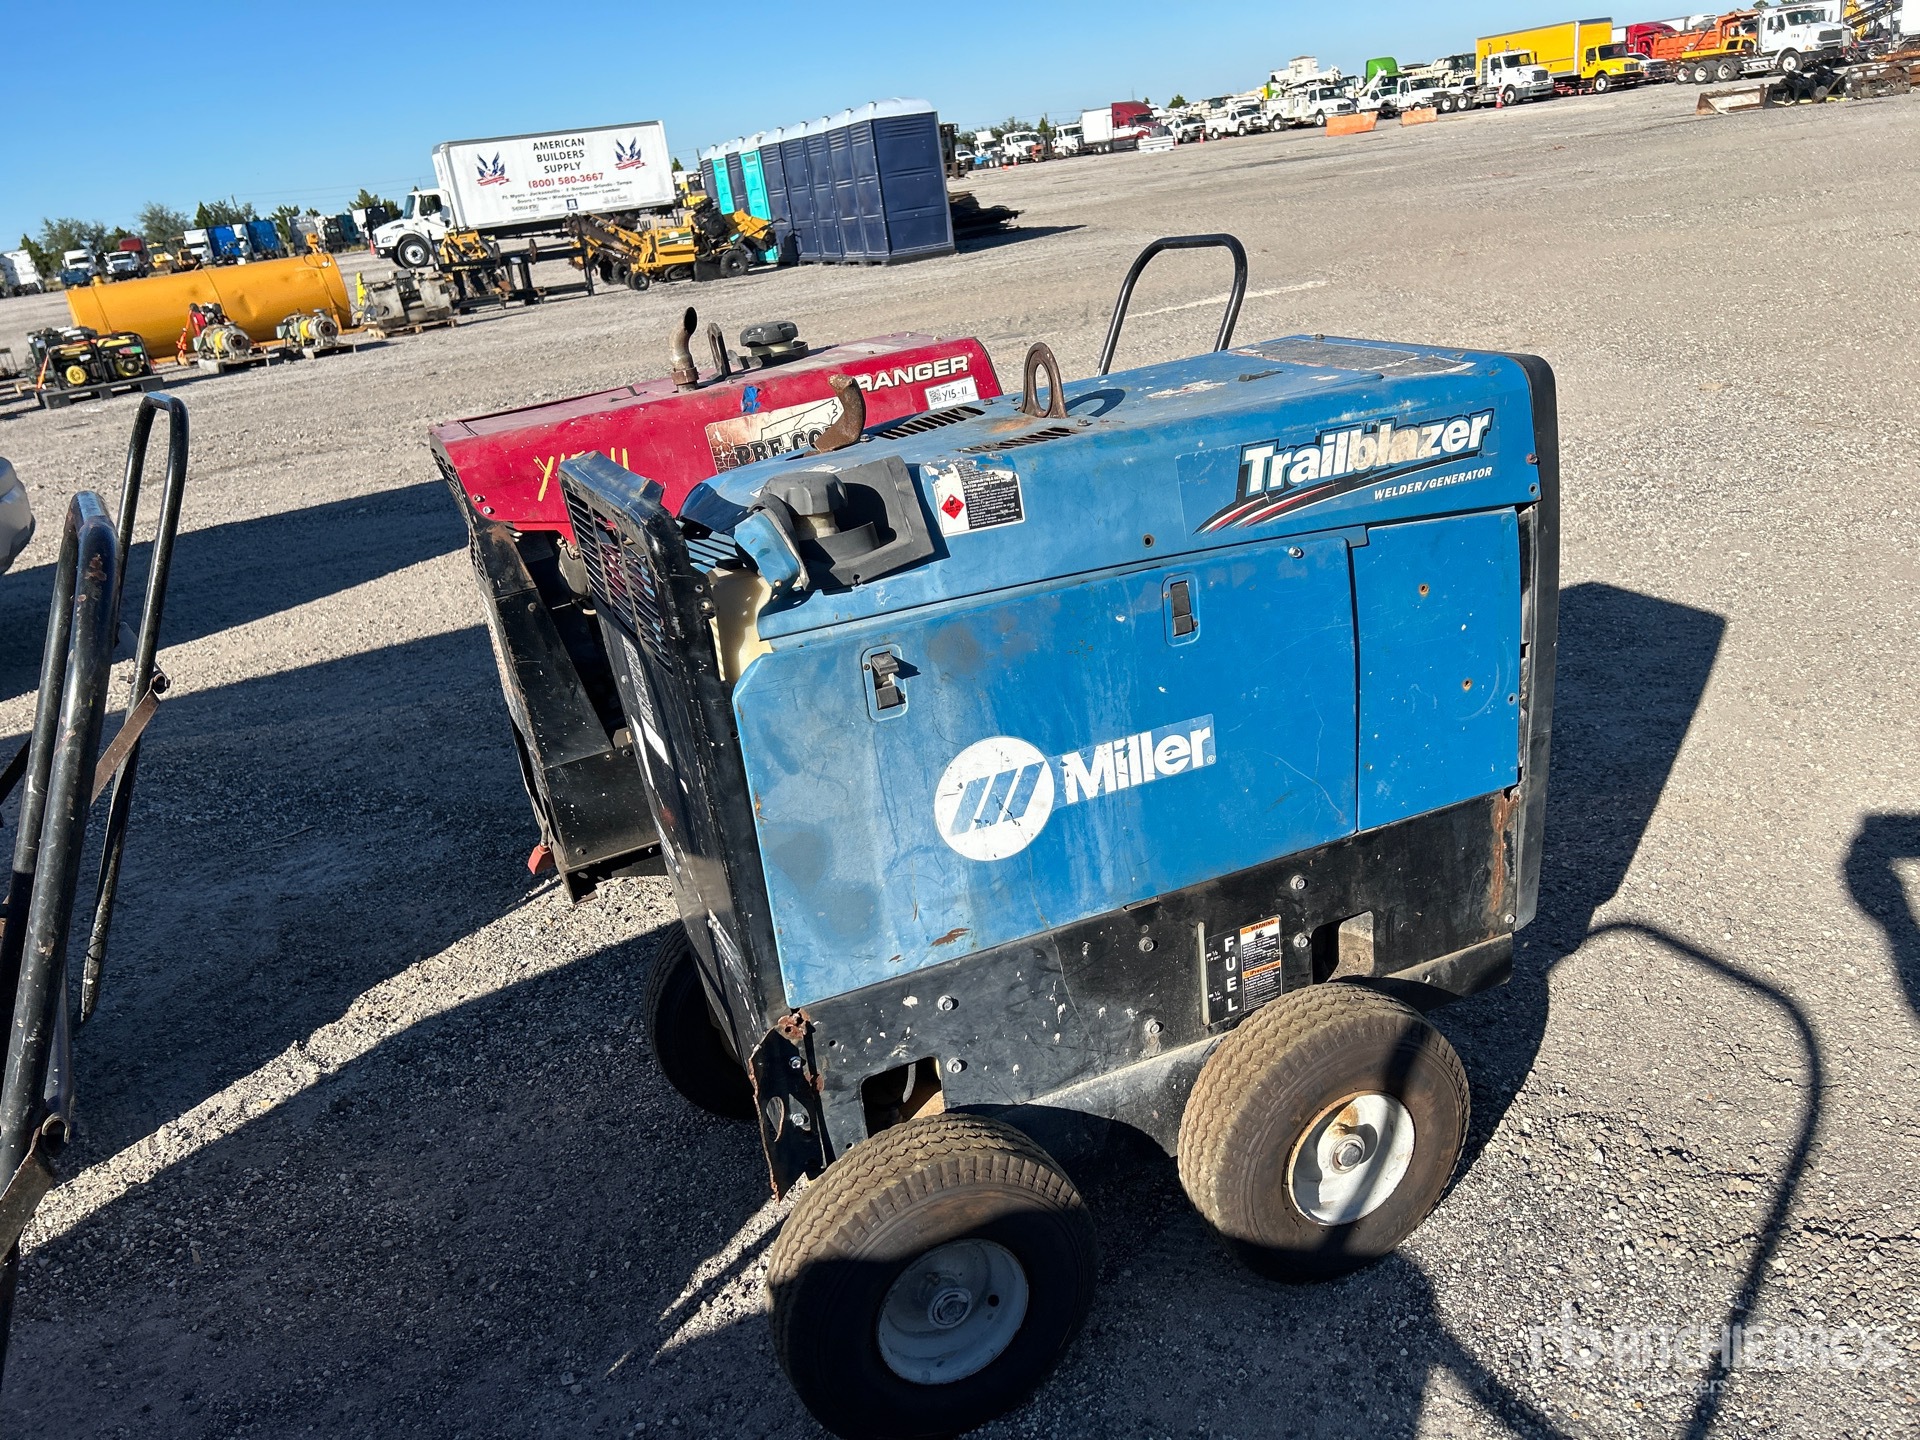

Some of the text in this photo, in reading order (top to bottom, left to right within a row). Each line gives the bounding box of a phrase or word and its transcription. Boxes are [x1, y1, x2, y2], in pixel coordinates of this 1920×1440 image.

[533, 138, 585, 151] AMERICAN
[536, 149, 585, 163] BUILDERS
[544, 162, 581, 174] SUPPLY
[528, 172, 604, 189] (800) 580-3667
[857, 354, 969, 392] RANGER
[942, 386, 967, 401] Y15-11
[1243, 411, 1492, 494] Trailblazer
[1374, 466, 1493, 500] WELDER/GENERATOR
[1062, 727, 1211, 804] Miller
